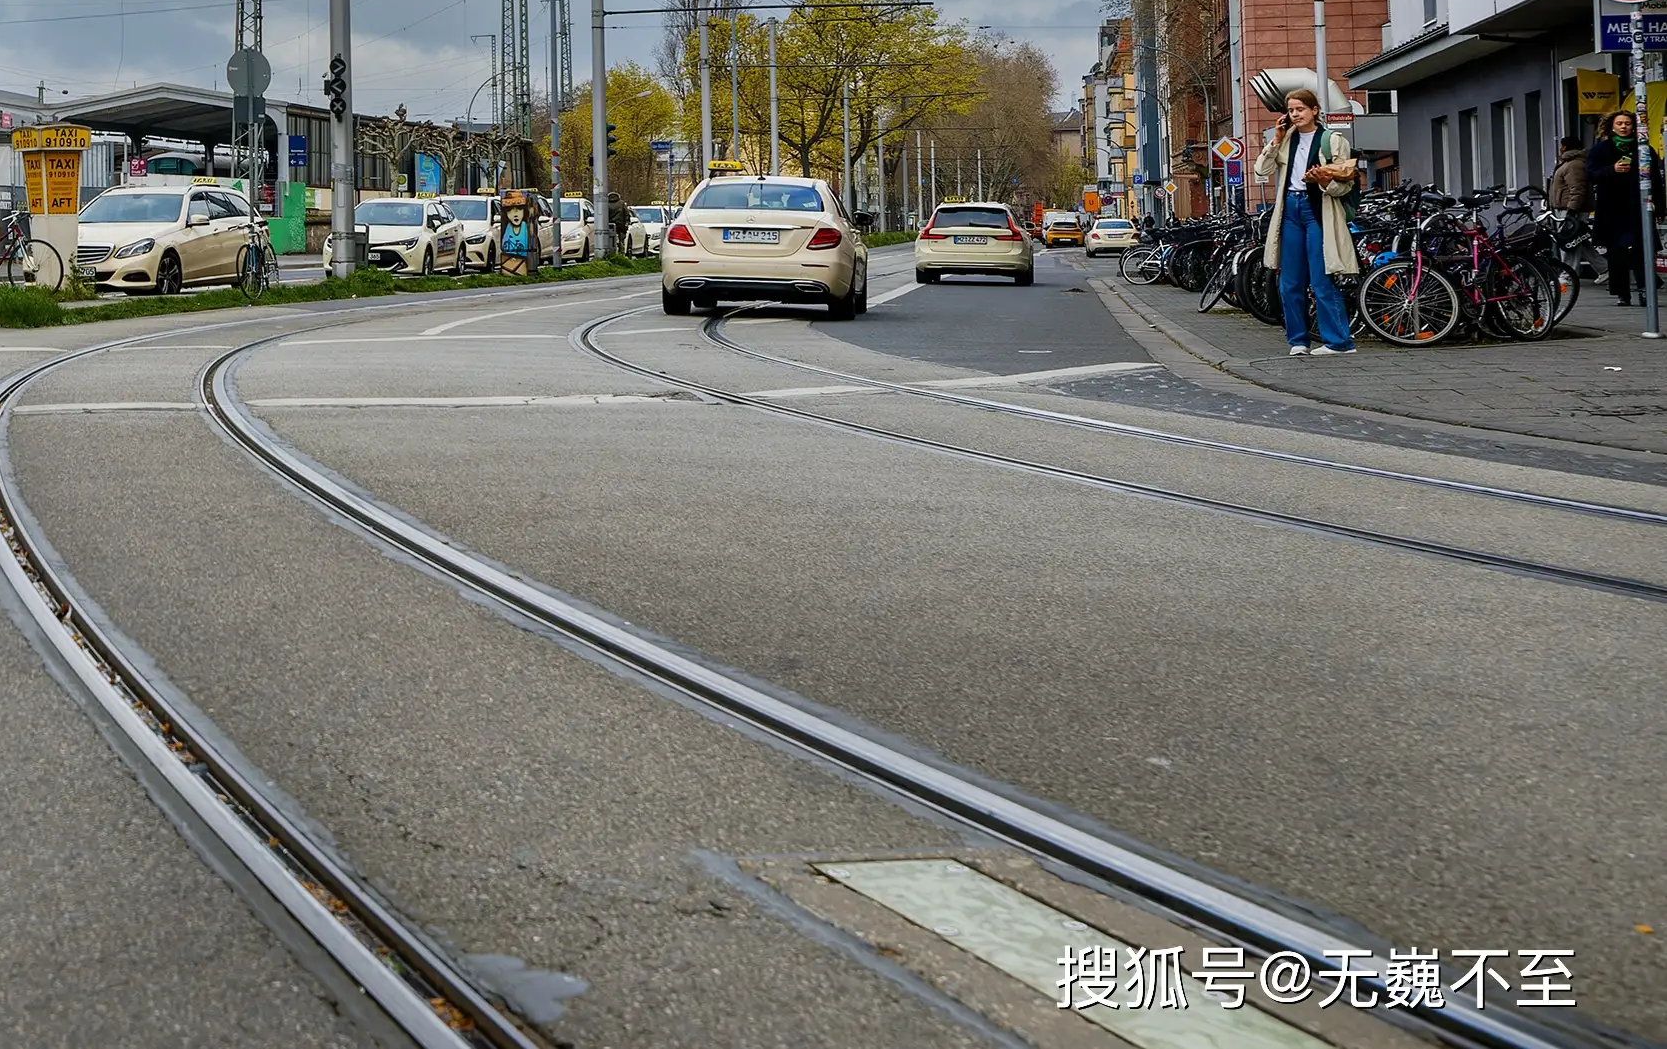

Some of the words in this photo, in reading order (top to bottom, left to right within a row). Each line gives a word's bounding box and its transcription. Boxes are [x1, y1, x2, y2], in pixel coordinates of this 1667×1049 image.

[1650, 35, 1667, 43] TRA
[19, 130, 33, 138] TAXI
[54, 128, 77, 137] TAXI
[16, 138, 38, 148] 910910
[45, 137, 86, 147] 910910
[26, 159, 41, 170] TAXI
[49, 159, 75, 169] TAXI
[31, 198, 42, 208] AFT
[51, 198, 72, 208] AFT
[729, 231, 740, 240] MZ
[761, 232, 778, 241] 215
[1565, 232, 1591, 249] adidas
